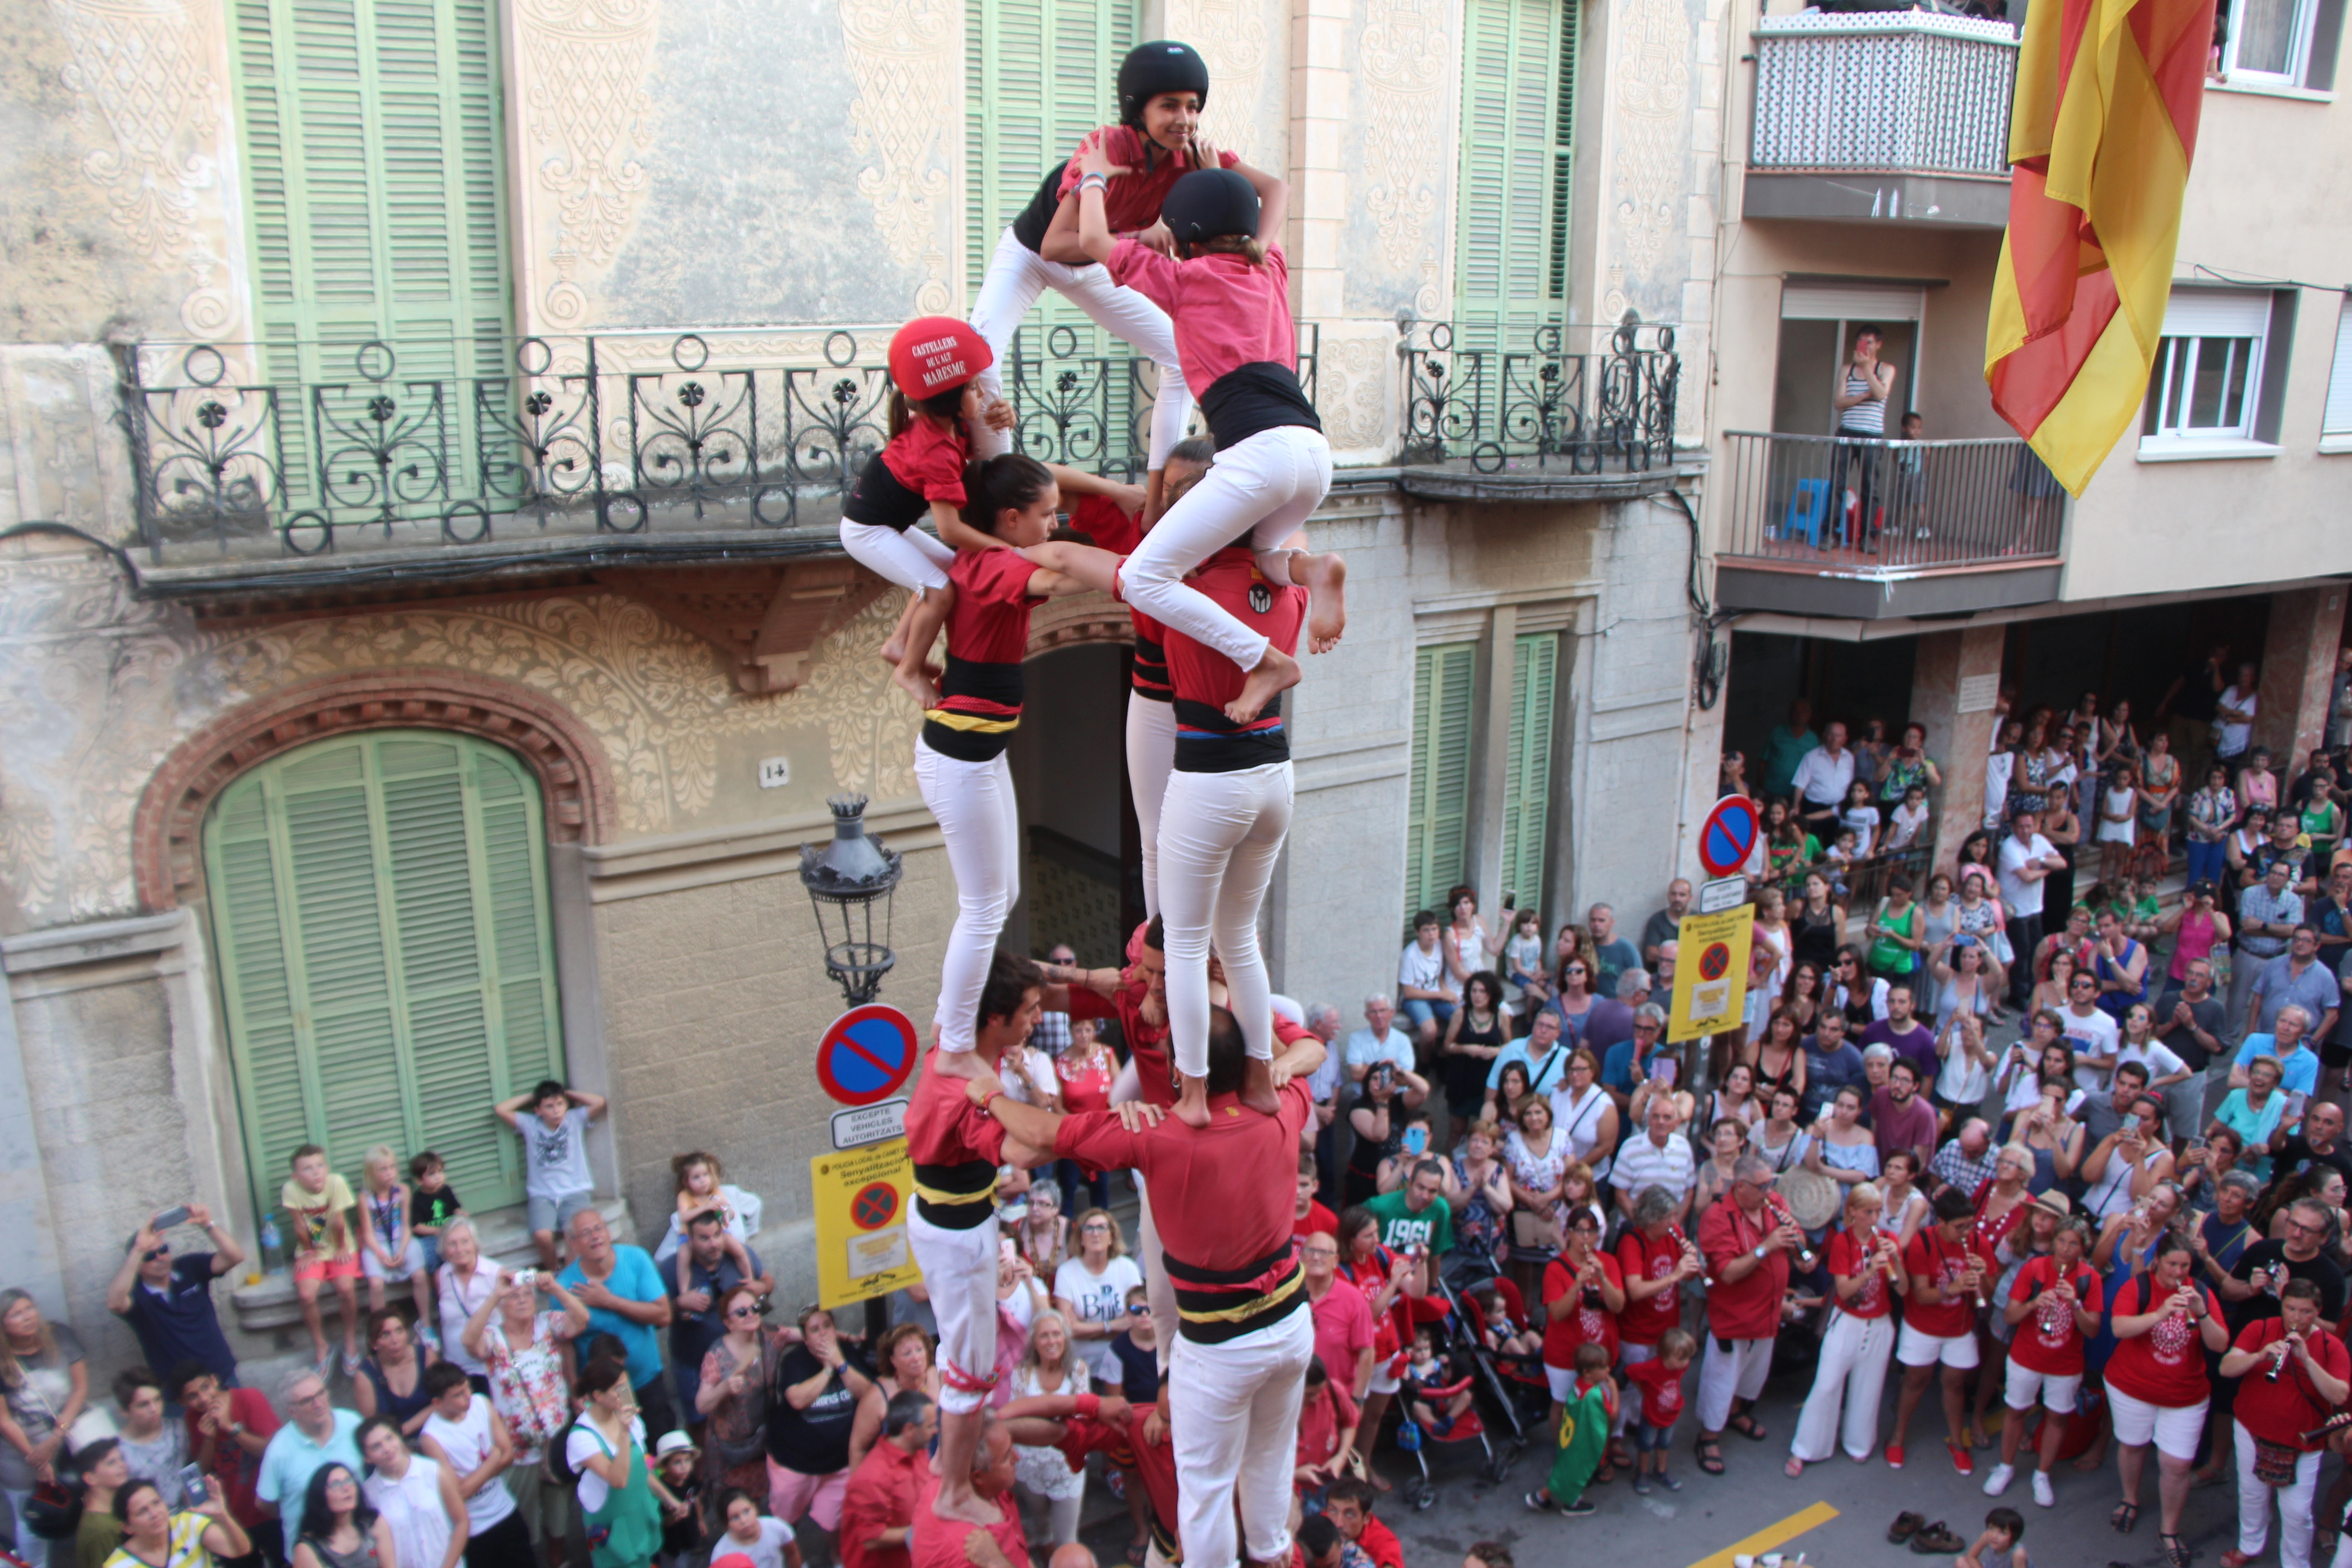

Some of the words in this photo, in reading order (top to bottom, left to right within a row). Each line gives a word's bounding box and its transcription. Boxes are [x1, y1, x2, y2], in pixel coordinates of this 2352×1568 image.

[911, 336, 957, 358] CASTELLERS
[926, 357, 936, 368] DE
[922, 360, 966, 387] MARESME
[766, 763, 784, 779] 14
[851, 1108, 890, 1122] EXCEPTE
[851, 1117, 892, 1132] VEHICLES
[843, 1125, 902, 1144] AUTORITZATS
[844, 1166, 901, 1186] excepcional
